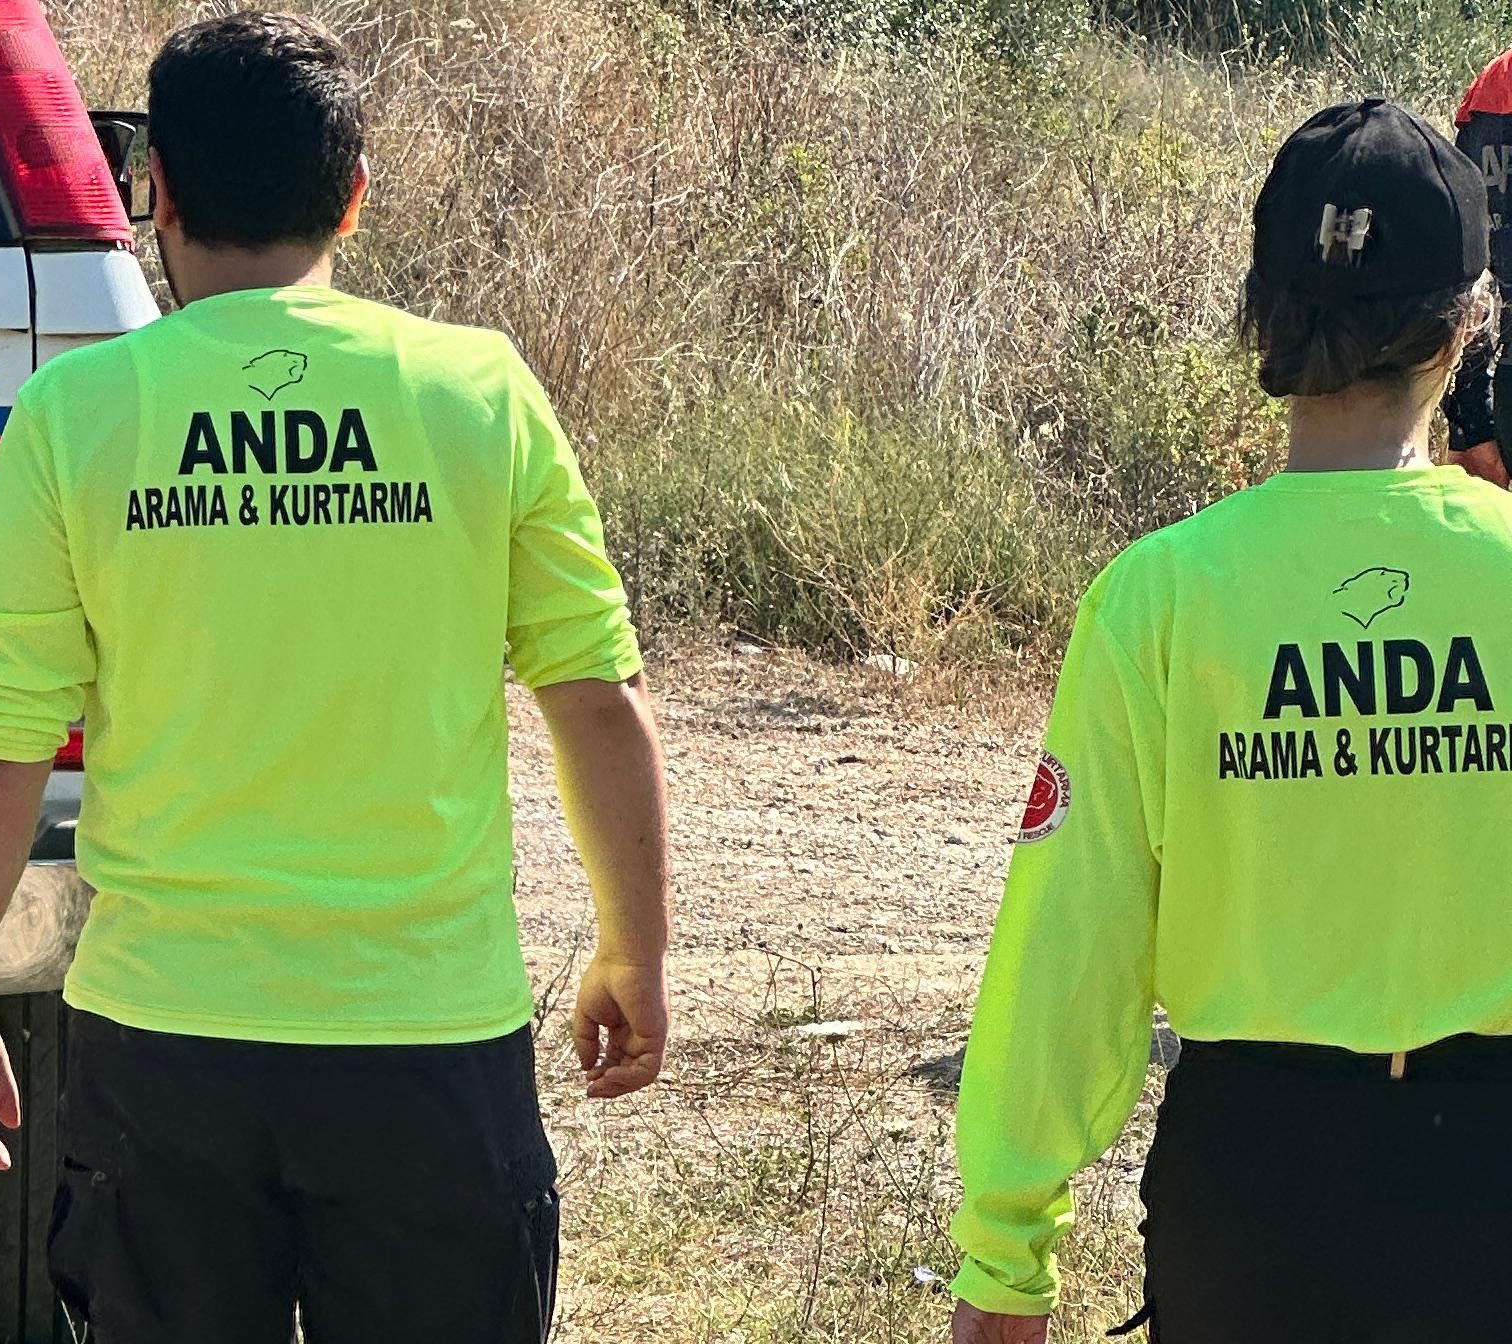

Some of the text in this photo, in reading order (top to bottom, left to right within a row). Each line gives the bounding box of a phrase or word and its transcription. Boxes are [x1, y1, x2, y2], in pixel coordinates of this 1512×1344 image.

[177, 408, 379, 476] ANDA
[125, 481, 434, 532] ARAMA & KURTARMA
[1262, 635, 1496, 720] ANDA
[1218, 722, 1512, 781] ARAMA & KURTAR
